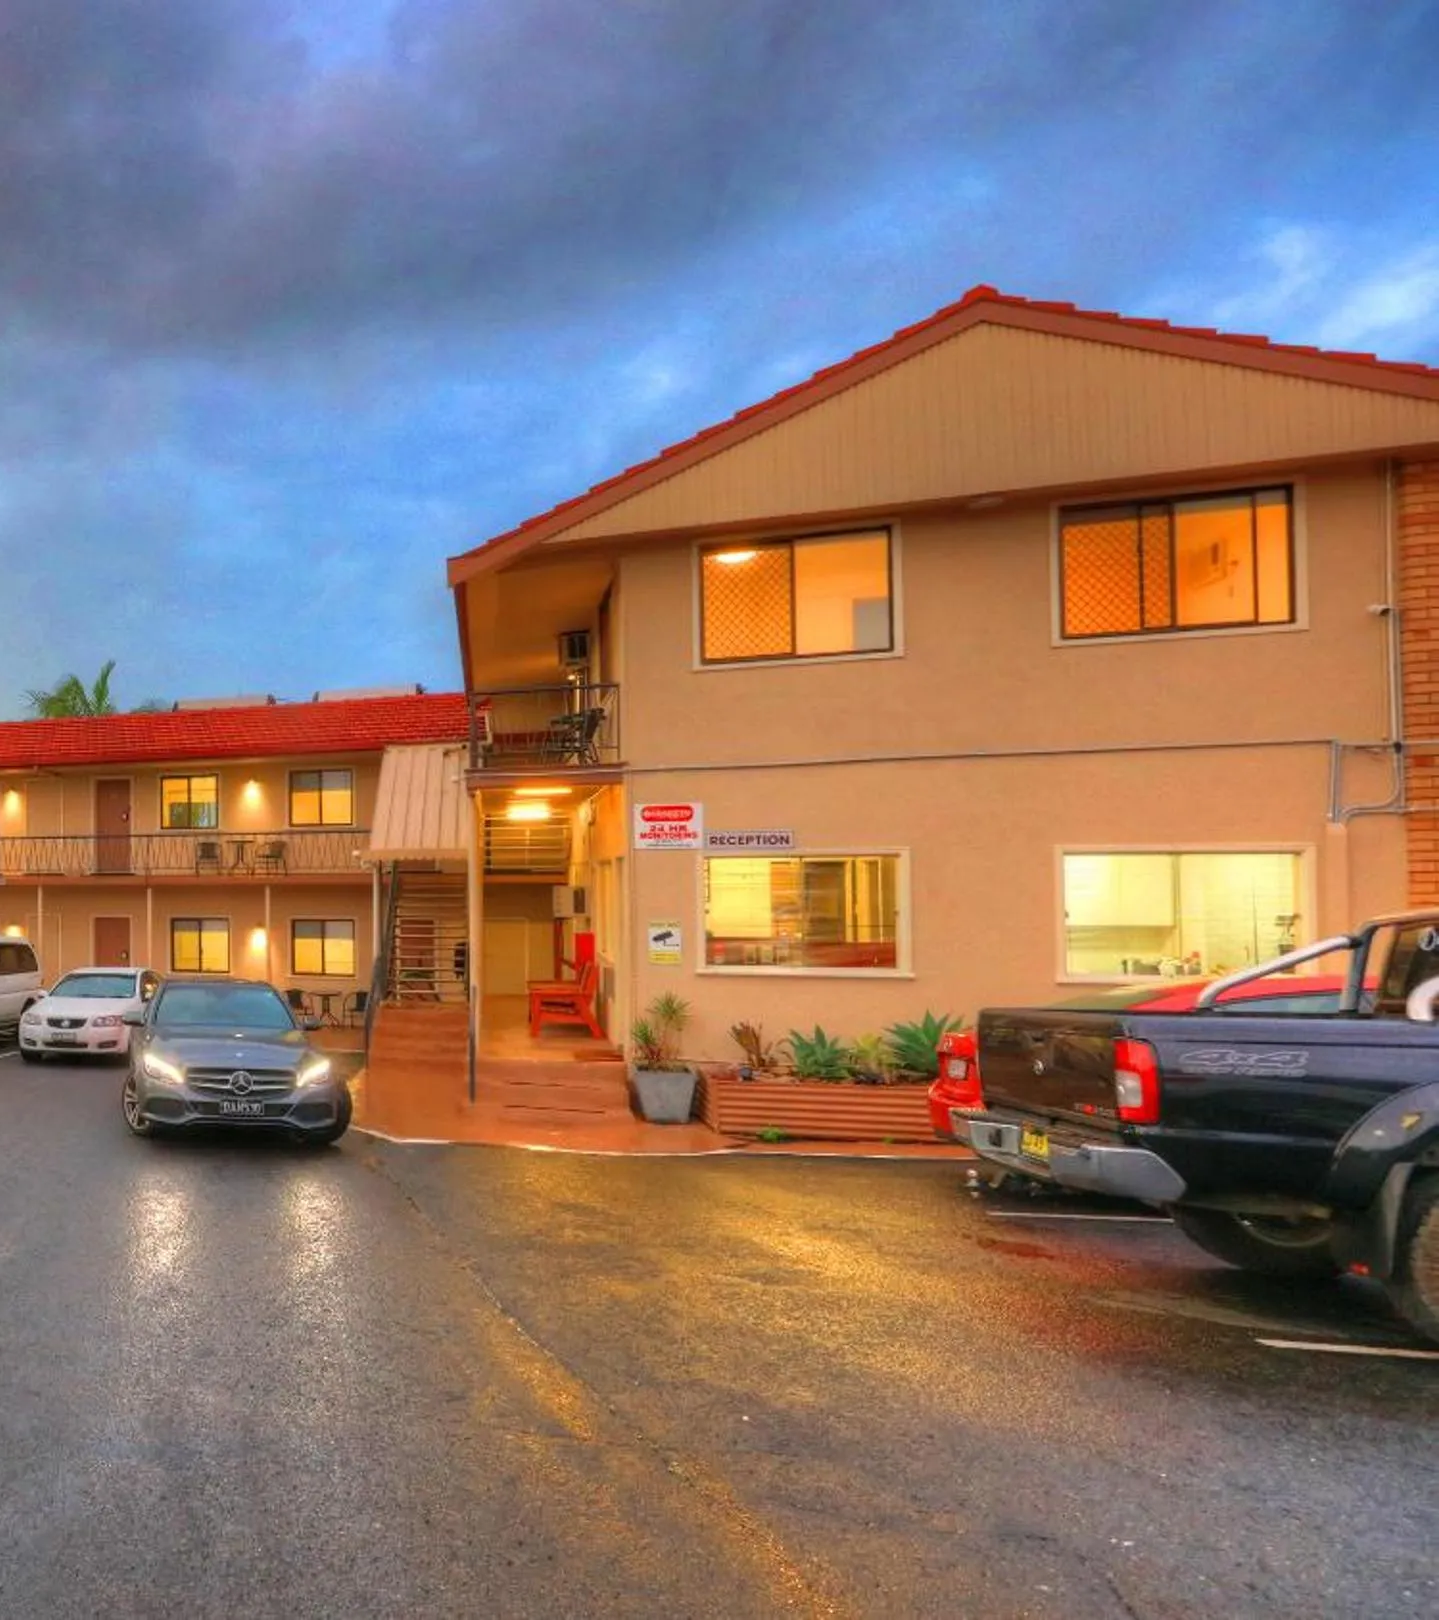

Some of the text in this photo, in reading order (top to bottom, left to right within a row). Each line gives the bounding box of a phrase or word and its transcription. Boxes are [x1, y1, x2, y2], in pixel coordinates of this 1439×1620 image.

[650, 824, 688, 832] 24 HR
[639, 831, 698, 840] MONITORING
[709, 835, 790, 846] RECEPTION
